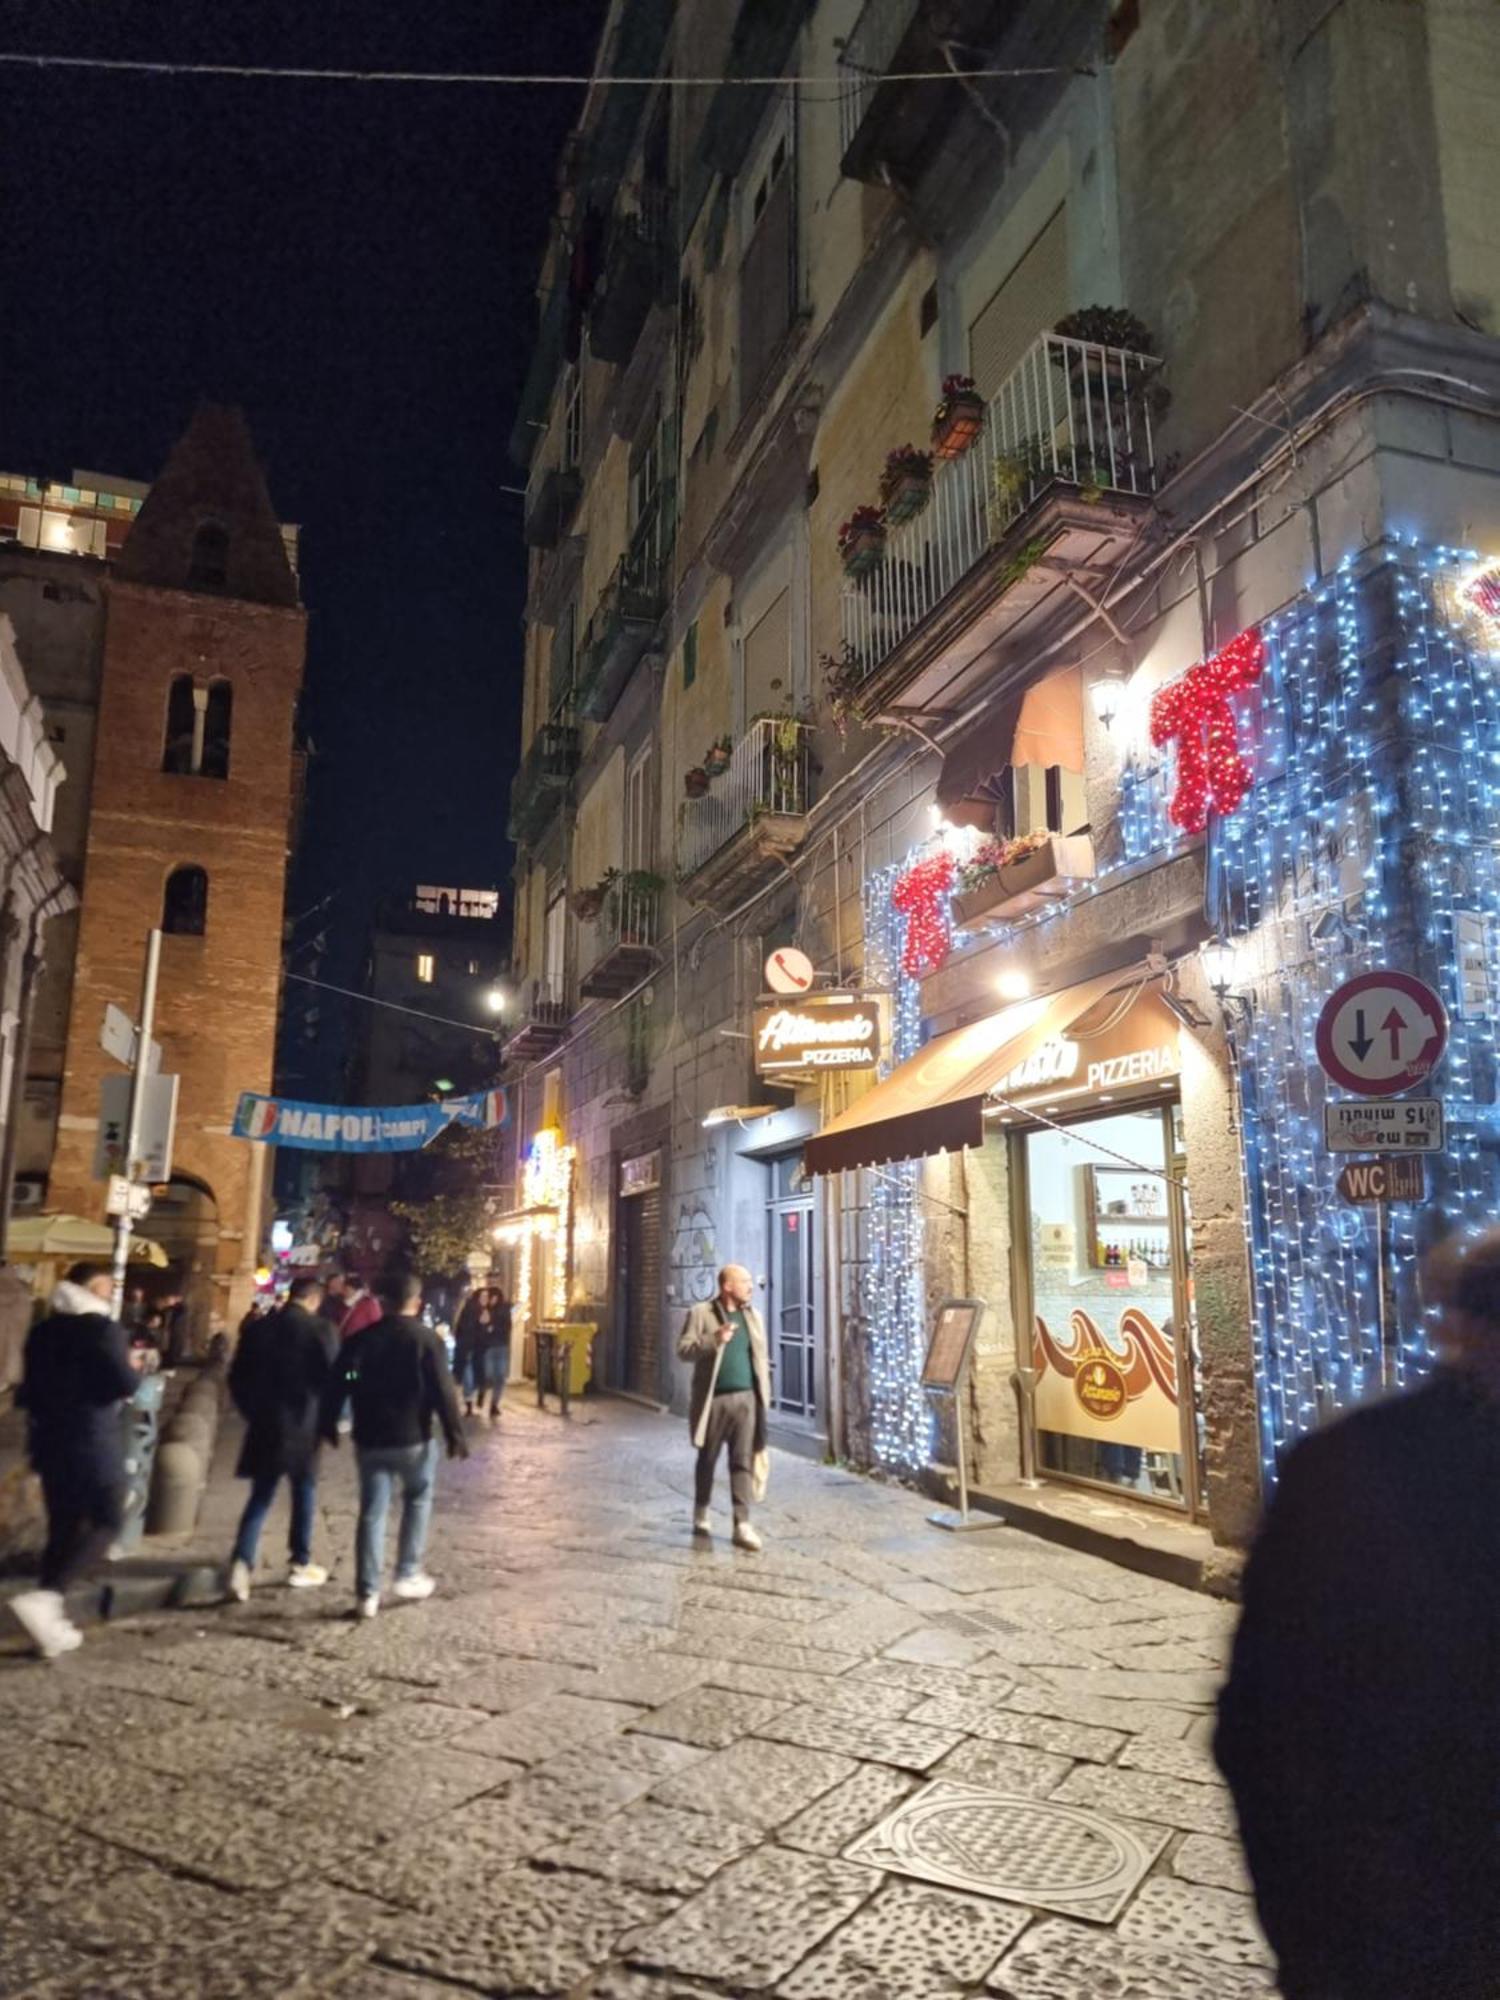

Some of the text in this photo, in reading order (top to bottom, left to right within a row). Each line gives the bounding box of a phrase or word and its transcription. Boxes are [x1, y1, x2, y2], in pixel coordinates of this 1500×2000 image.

[801, 1047, 873, 1064] PIZZERIA
[1087, 1045, 1174, 1089] PIZZERIA
[1340, 1107, 1426, 1126] 15 minuti
[1345, 1165, 1385, 1198] WC
